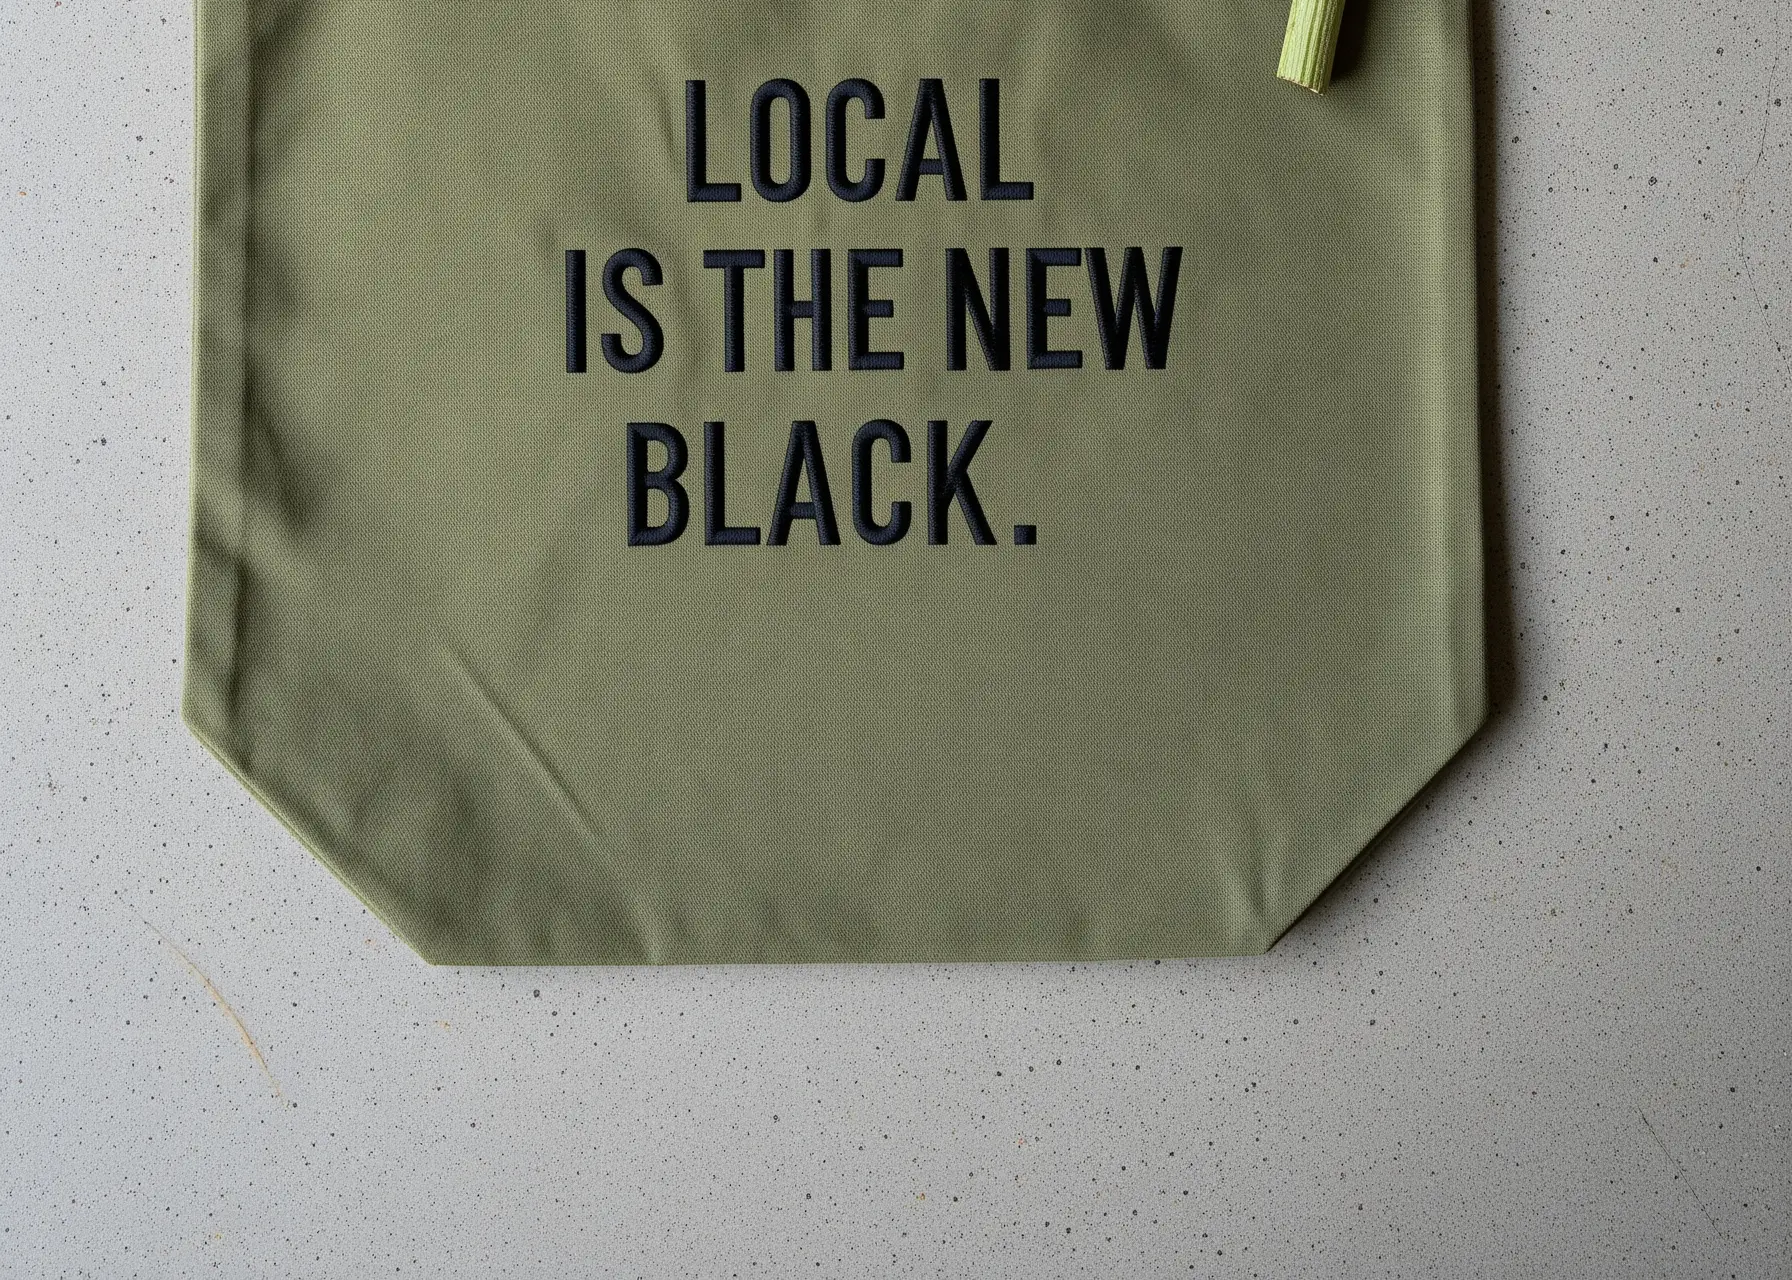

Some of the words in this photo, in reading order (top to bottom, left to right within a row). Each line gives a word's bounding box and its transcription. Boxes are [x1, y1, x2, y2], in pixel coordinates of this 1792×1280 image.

[685, 78, 1035, 204] LOCAL
[564, 247, 665, 375] IS
[702, 248, 905, 374] THE
[944, 246, 1184, 373] NEW
[625, 419, 1037, 548] BLACK.
